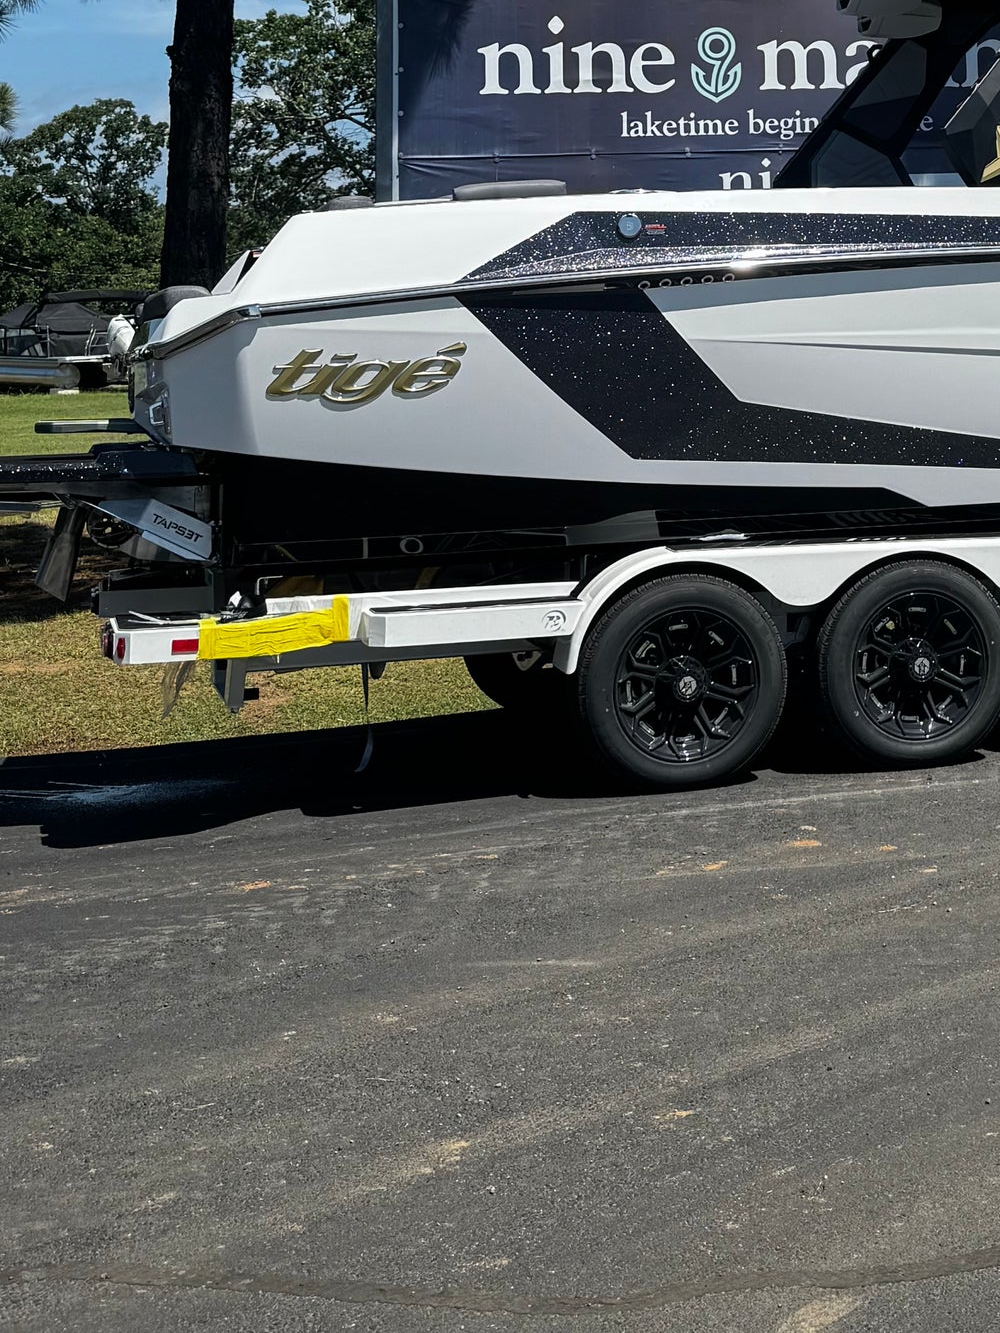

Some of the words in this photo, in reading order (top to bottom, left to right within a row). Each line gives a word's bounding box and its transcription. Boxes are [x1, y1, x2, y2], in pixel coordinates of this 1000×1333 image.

[477, 15, 676, 95] nine
[620, 111, 739, 138] laketime
[747, 109, 818, 139] begin
[266, 342, 467, 404] tigé
